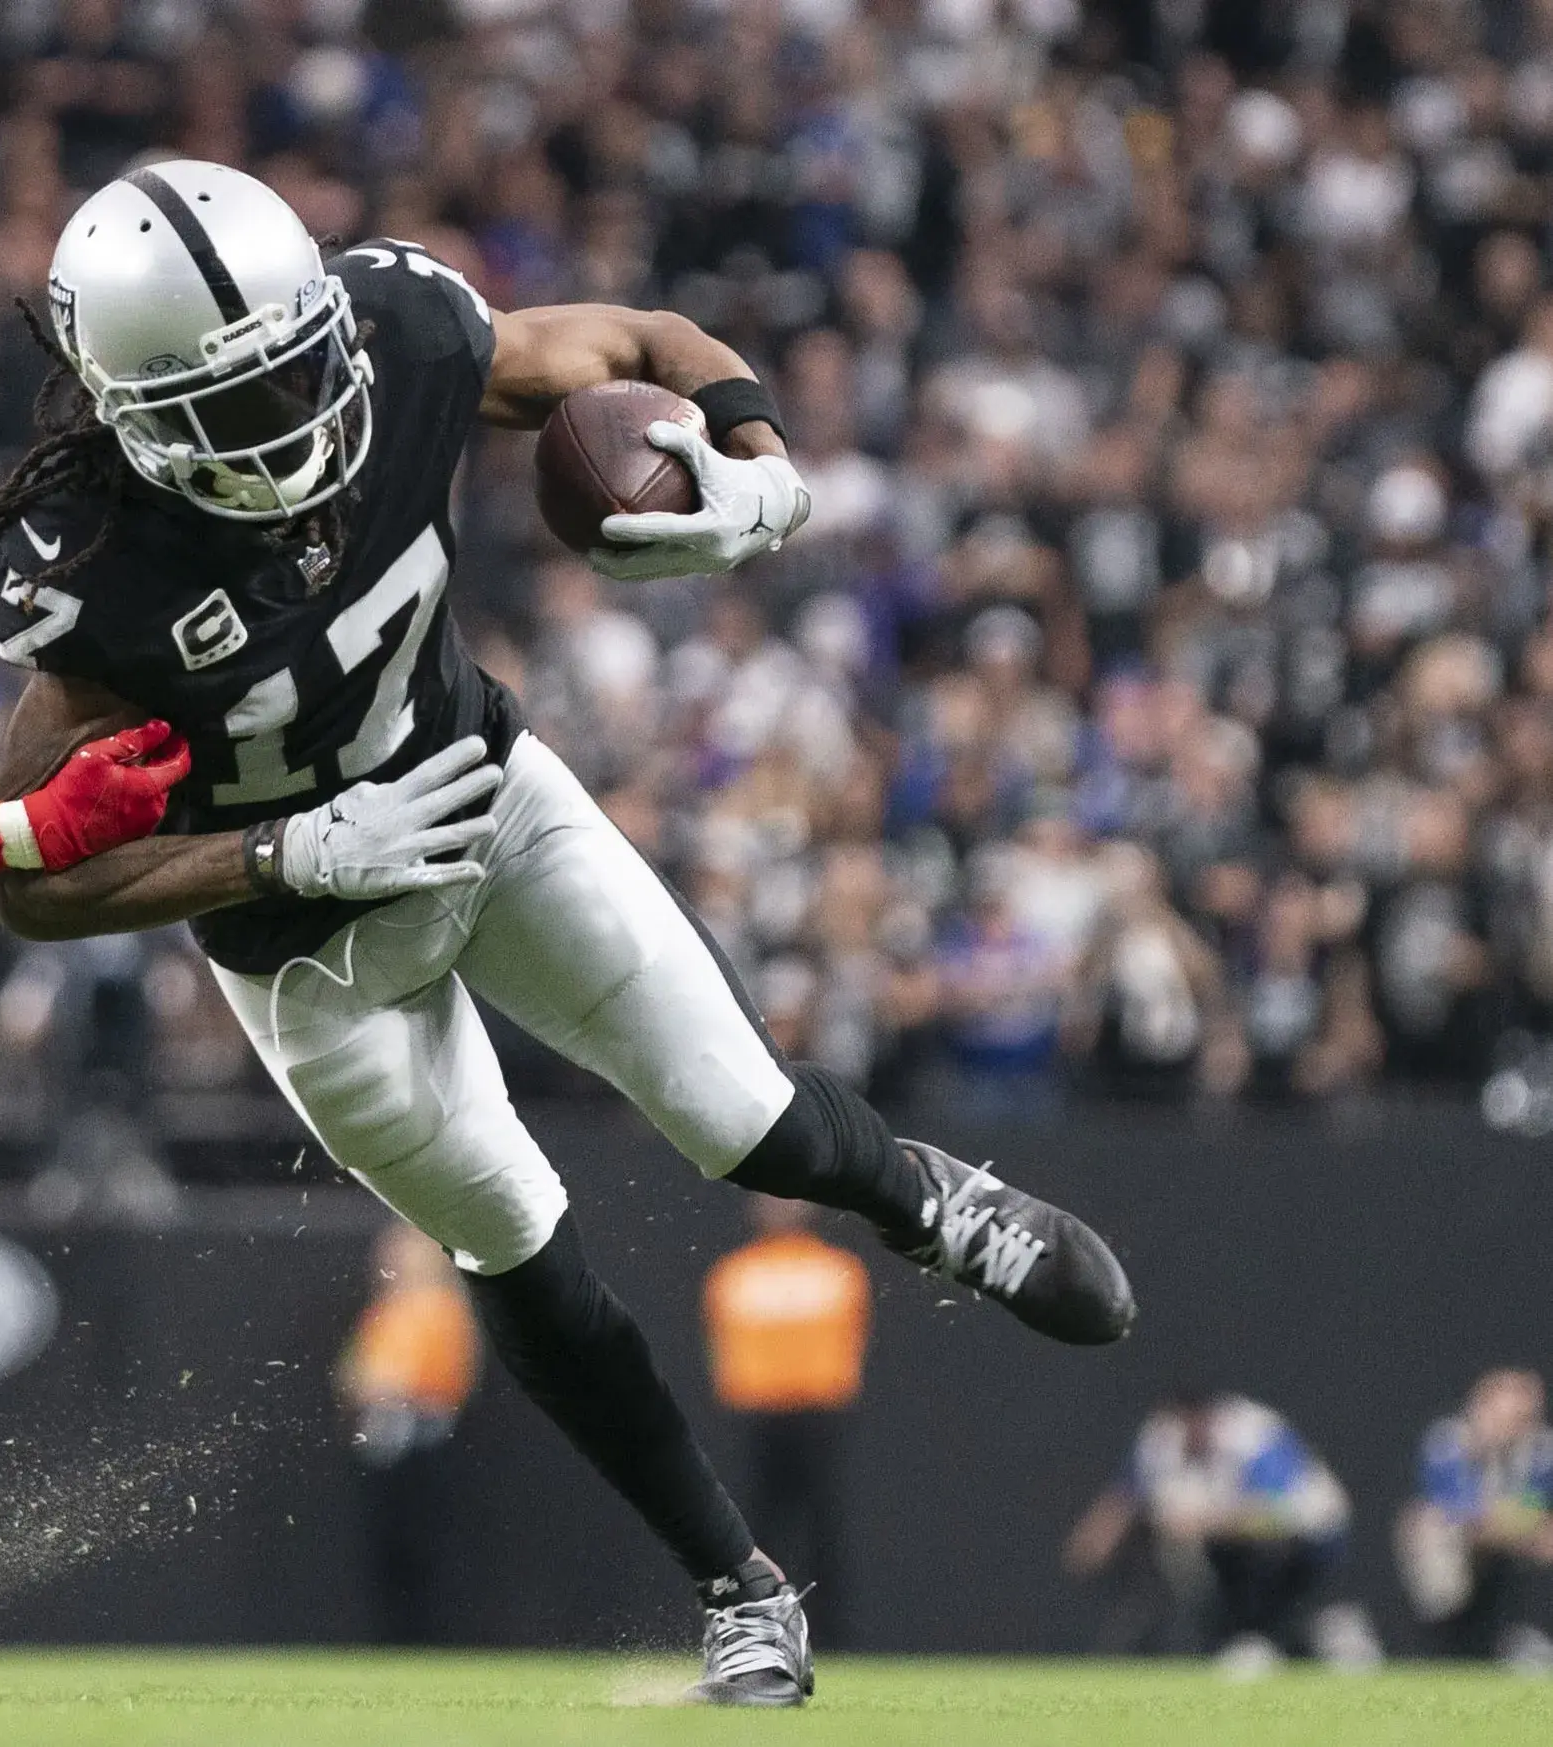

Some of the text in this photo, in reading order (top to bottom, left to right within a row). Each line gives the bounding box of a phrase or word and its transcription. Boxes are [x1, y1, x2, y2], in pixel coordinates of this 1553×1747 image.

[222, 319, 262, 343] RAIDERS
[182, 599, 234, 656] C
[213, 522, 449, 806] 17
